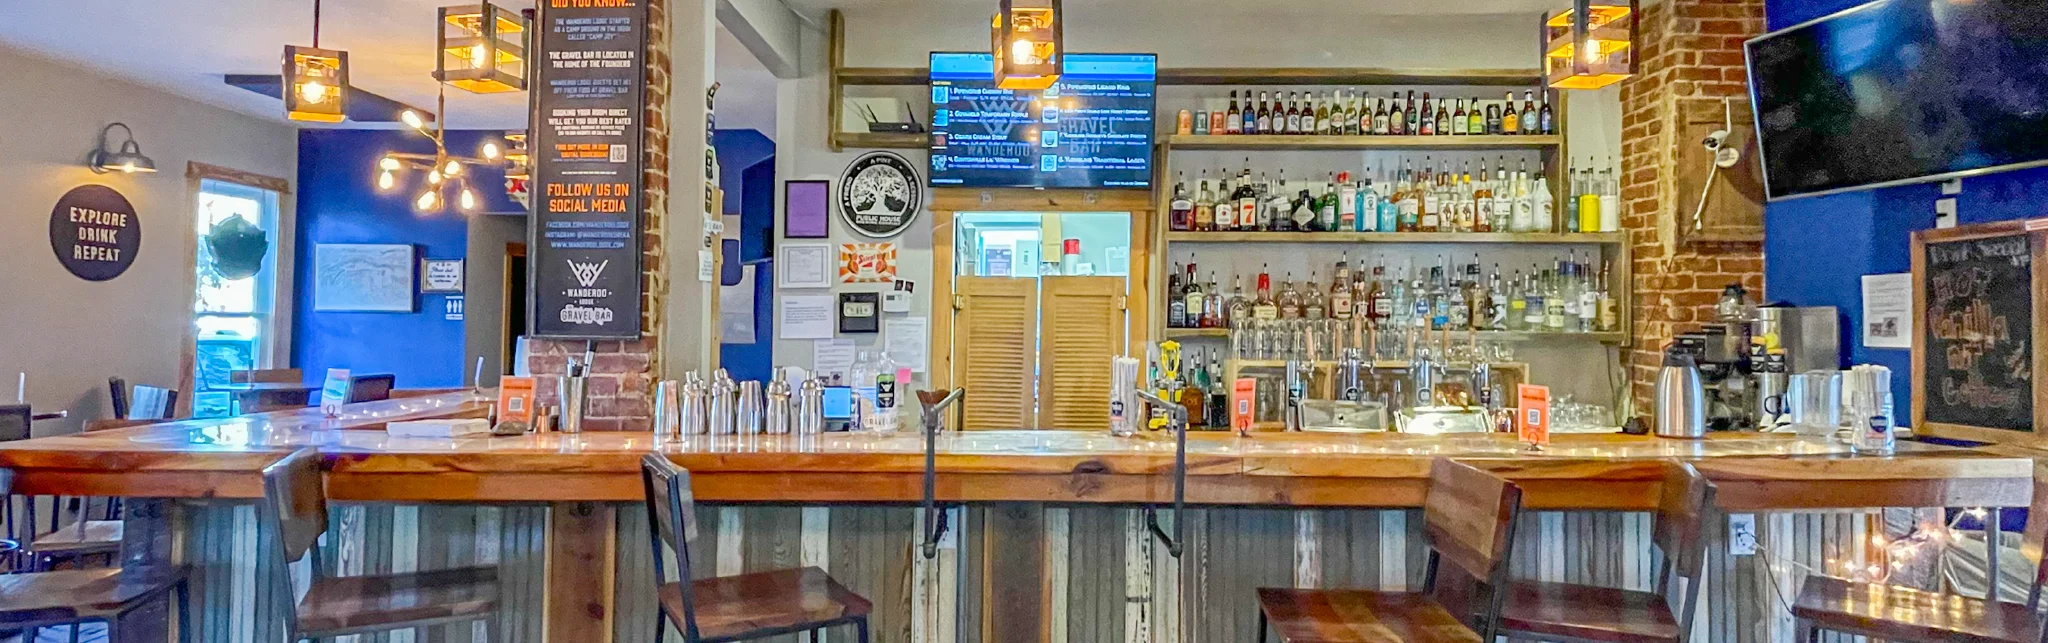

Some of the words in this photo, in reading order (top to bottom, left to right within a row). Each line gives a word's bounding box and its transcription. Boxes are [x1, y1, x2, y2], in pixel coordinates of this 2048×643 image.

[581, 60, 588, 68] OF
[590, 60, 600, 68] THE
[548, 184, 592, 196] FOLLOW
[596, 184, 610, 196] US
[614, 184, 629, 196] ON
[550, 199, 588, 212] SOCIAL
[592, 199, 626, 212] MEDIA
[70, 207, 127, 227] EXPLORE
[1243, 204, 1254, 223] 7
[78, 227, 118, 244] DRINK
[74, 245, 121, 261] REPEAT
[567, 289, 607, 297] WANDEROO
[562, 310, 592, 320] GRAVEL
[595, 310, 611, 320] BAR
